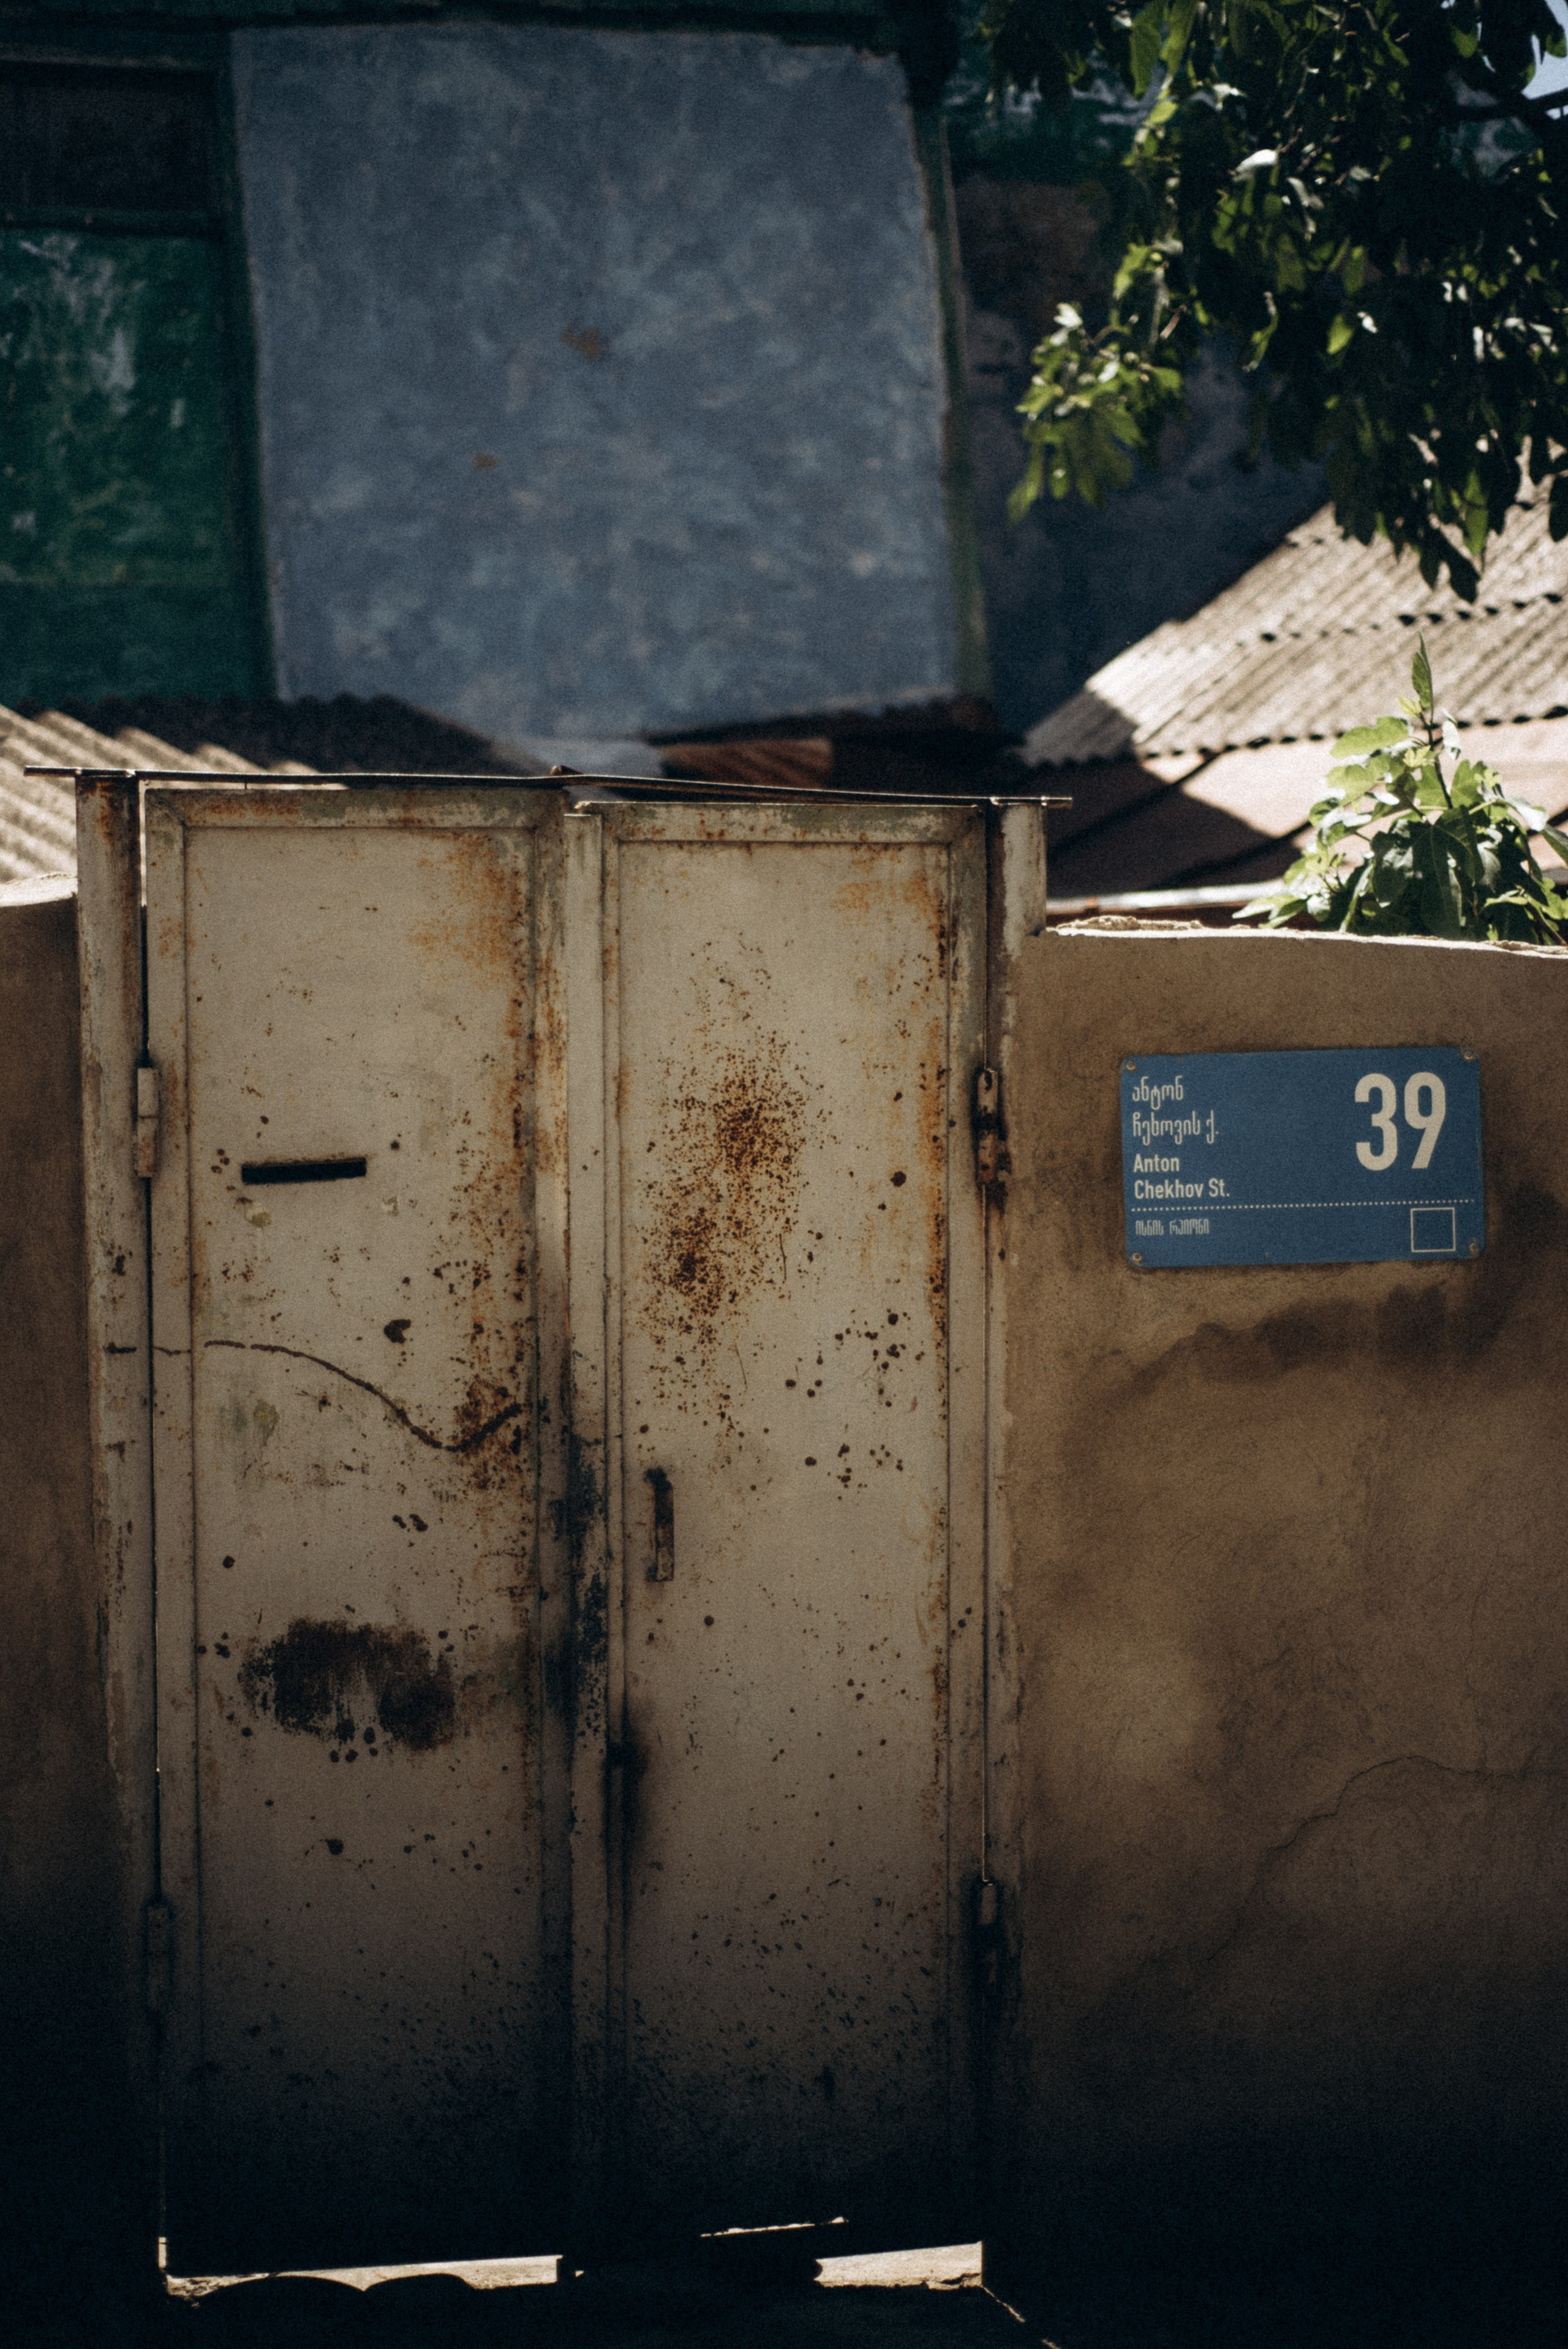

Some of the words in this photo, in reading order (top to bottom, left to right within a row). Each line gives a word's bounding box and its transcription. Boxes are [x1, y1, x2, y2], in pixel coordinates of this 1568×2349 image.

[1133, 1076, 1183, 1110] ანტონ
[1133, 1110, 1200, 1145] ჩეხოვის
[1206, 1110, 1219, 1144] ქ.
[1354, 1072, 1446, 1171] 39
[1133, 1153, 1180, 1172] Anton
[1134, 1179, 1204, 1199] Chekhov
[1208, 1178, 1230, 1197] St.
